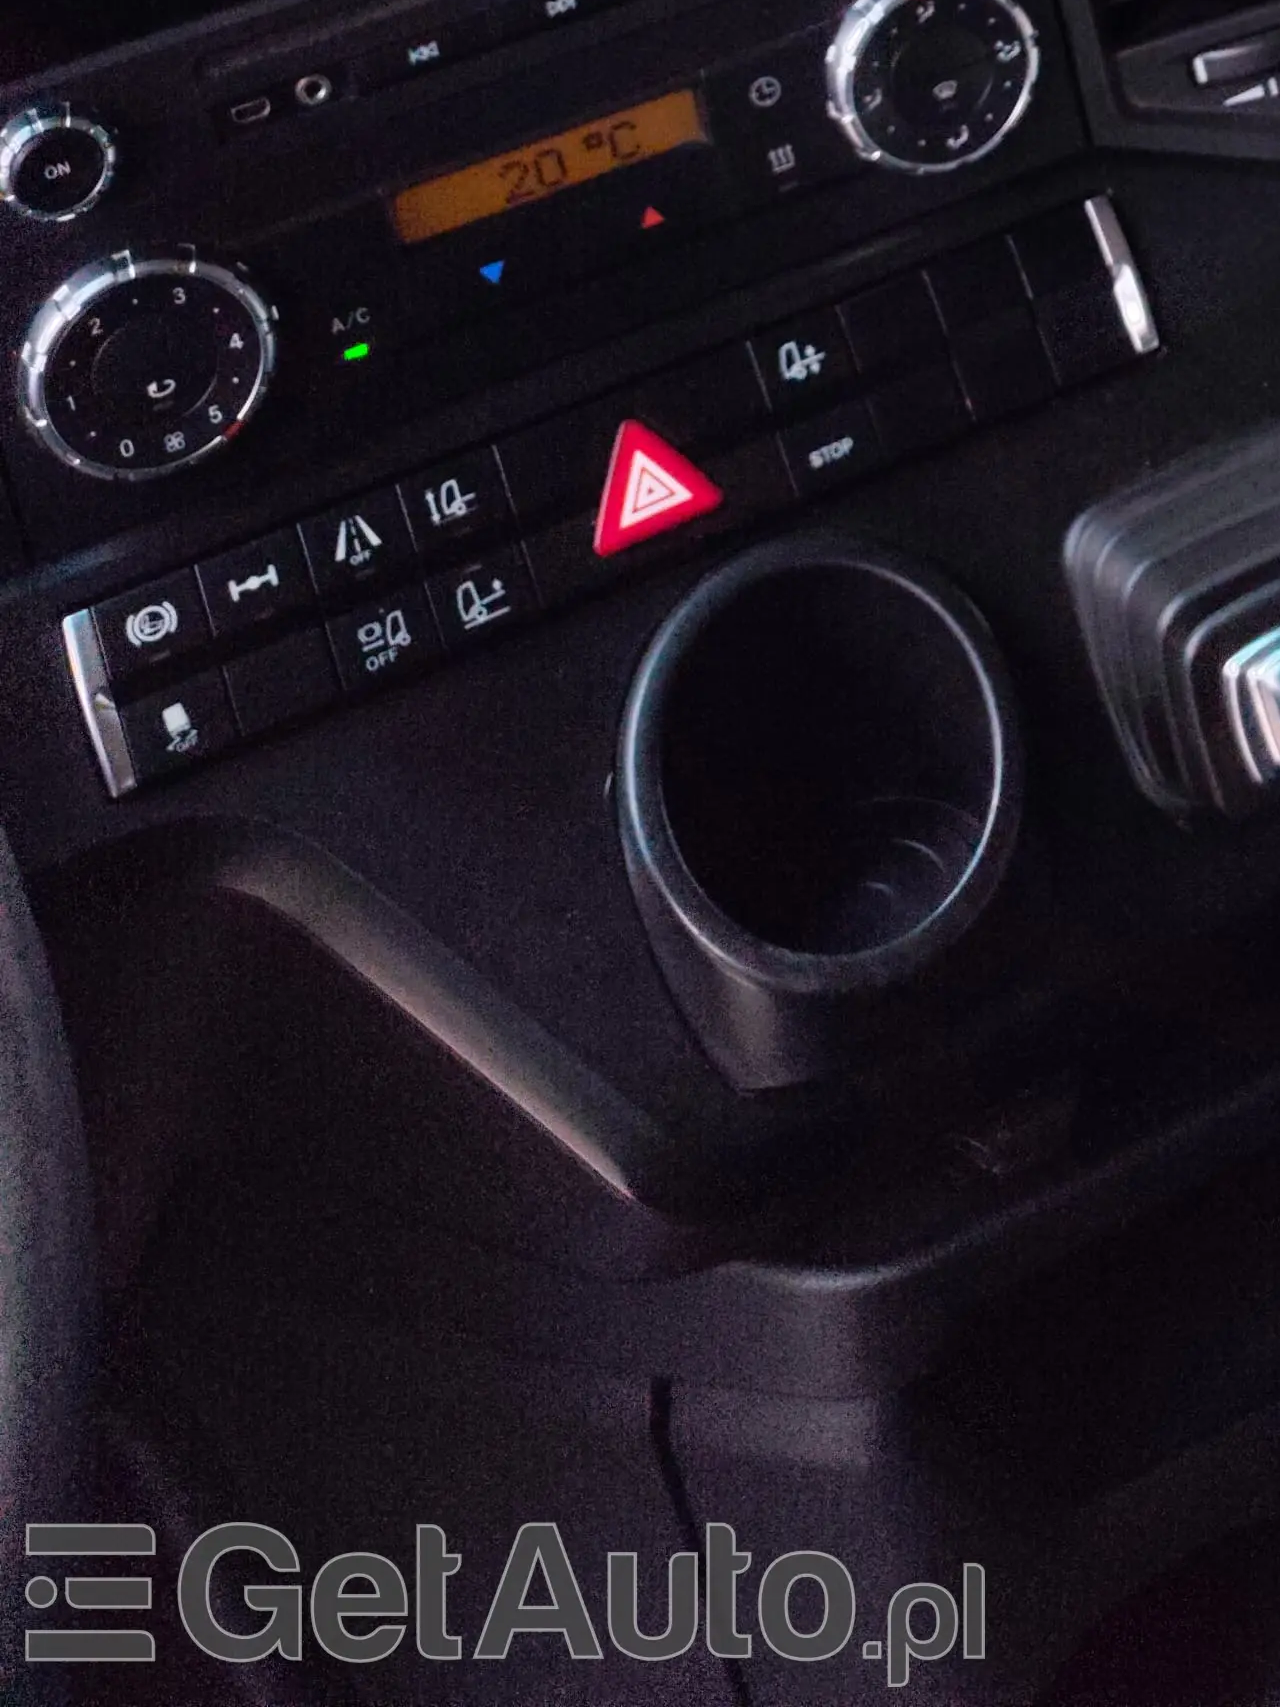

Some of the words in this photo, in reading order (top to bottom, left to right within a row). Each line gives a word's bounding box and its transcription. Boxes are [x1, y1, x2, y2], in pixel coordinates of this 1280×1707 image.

[44, 161, 71, 180] ON
[500, 147, 568, 206] 20
[172, 286, 187, 305] 3
[89, 317, 104, 336] 2
[331, 306, 371, 334] A/C
[228, 332, 245, 350] 4
[207, 404, 223, 424] 5
[119, 438, 135, 458] 0
[808, 436, 854, 468] STOP
[365, 649, 398, 672] OFF
